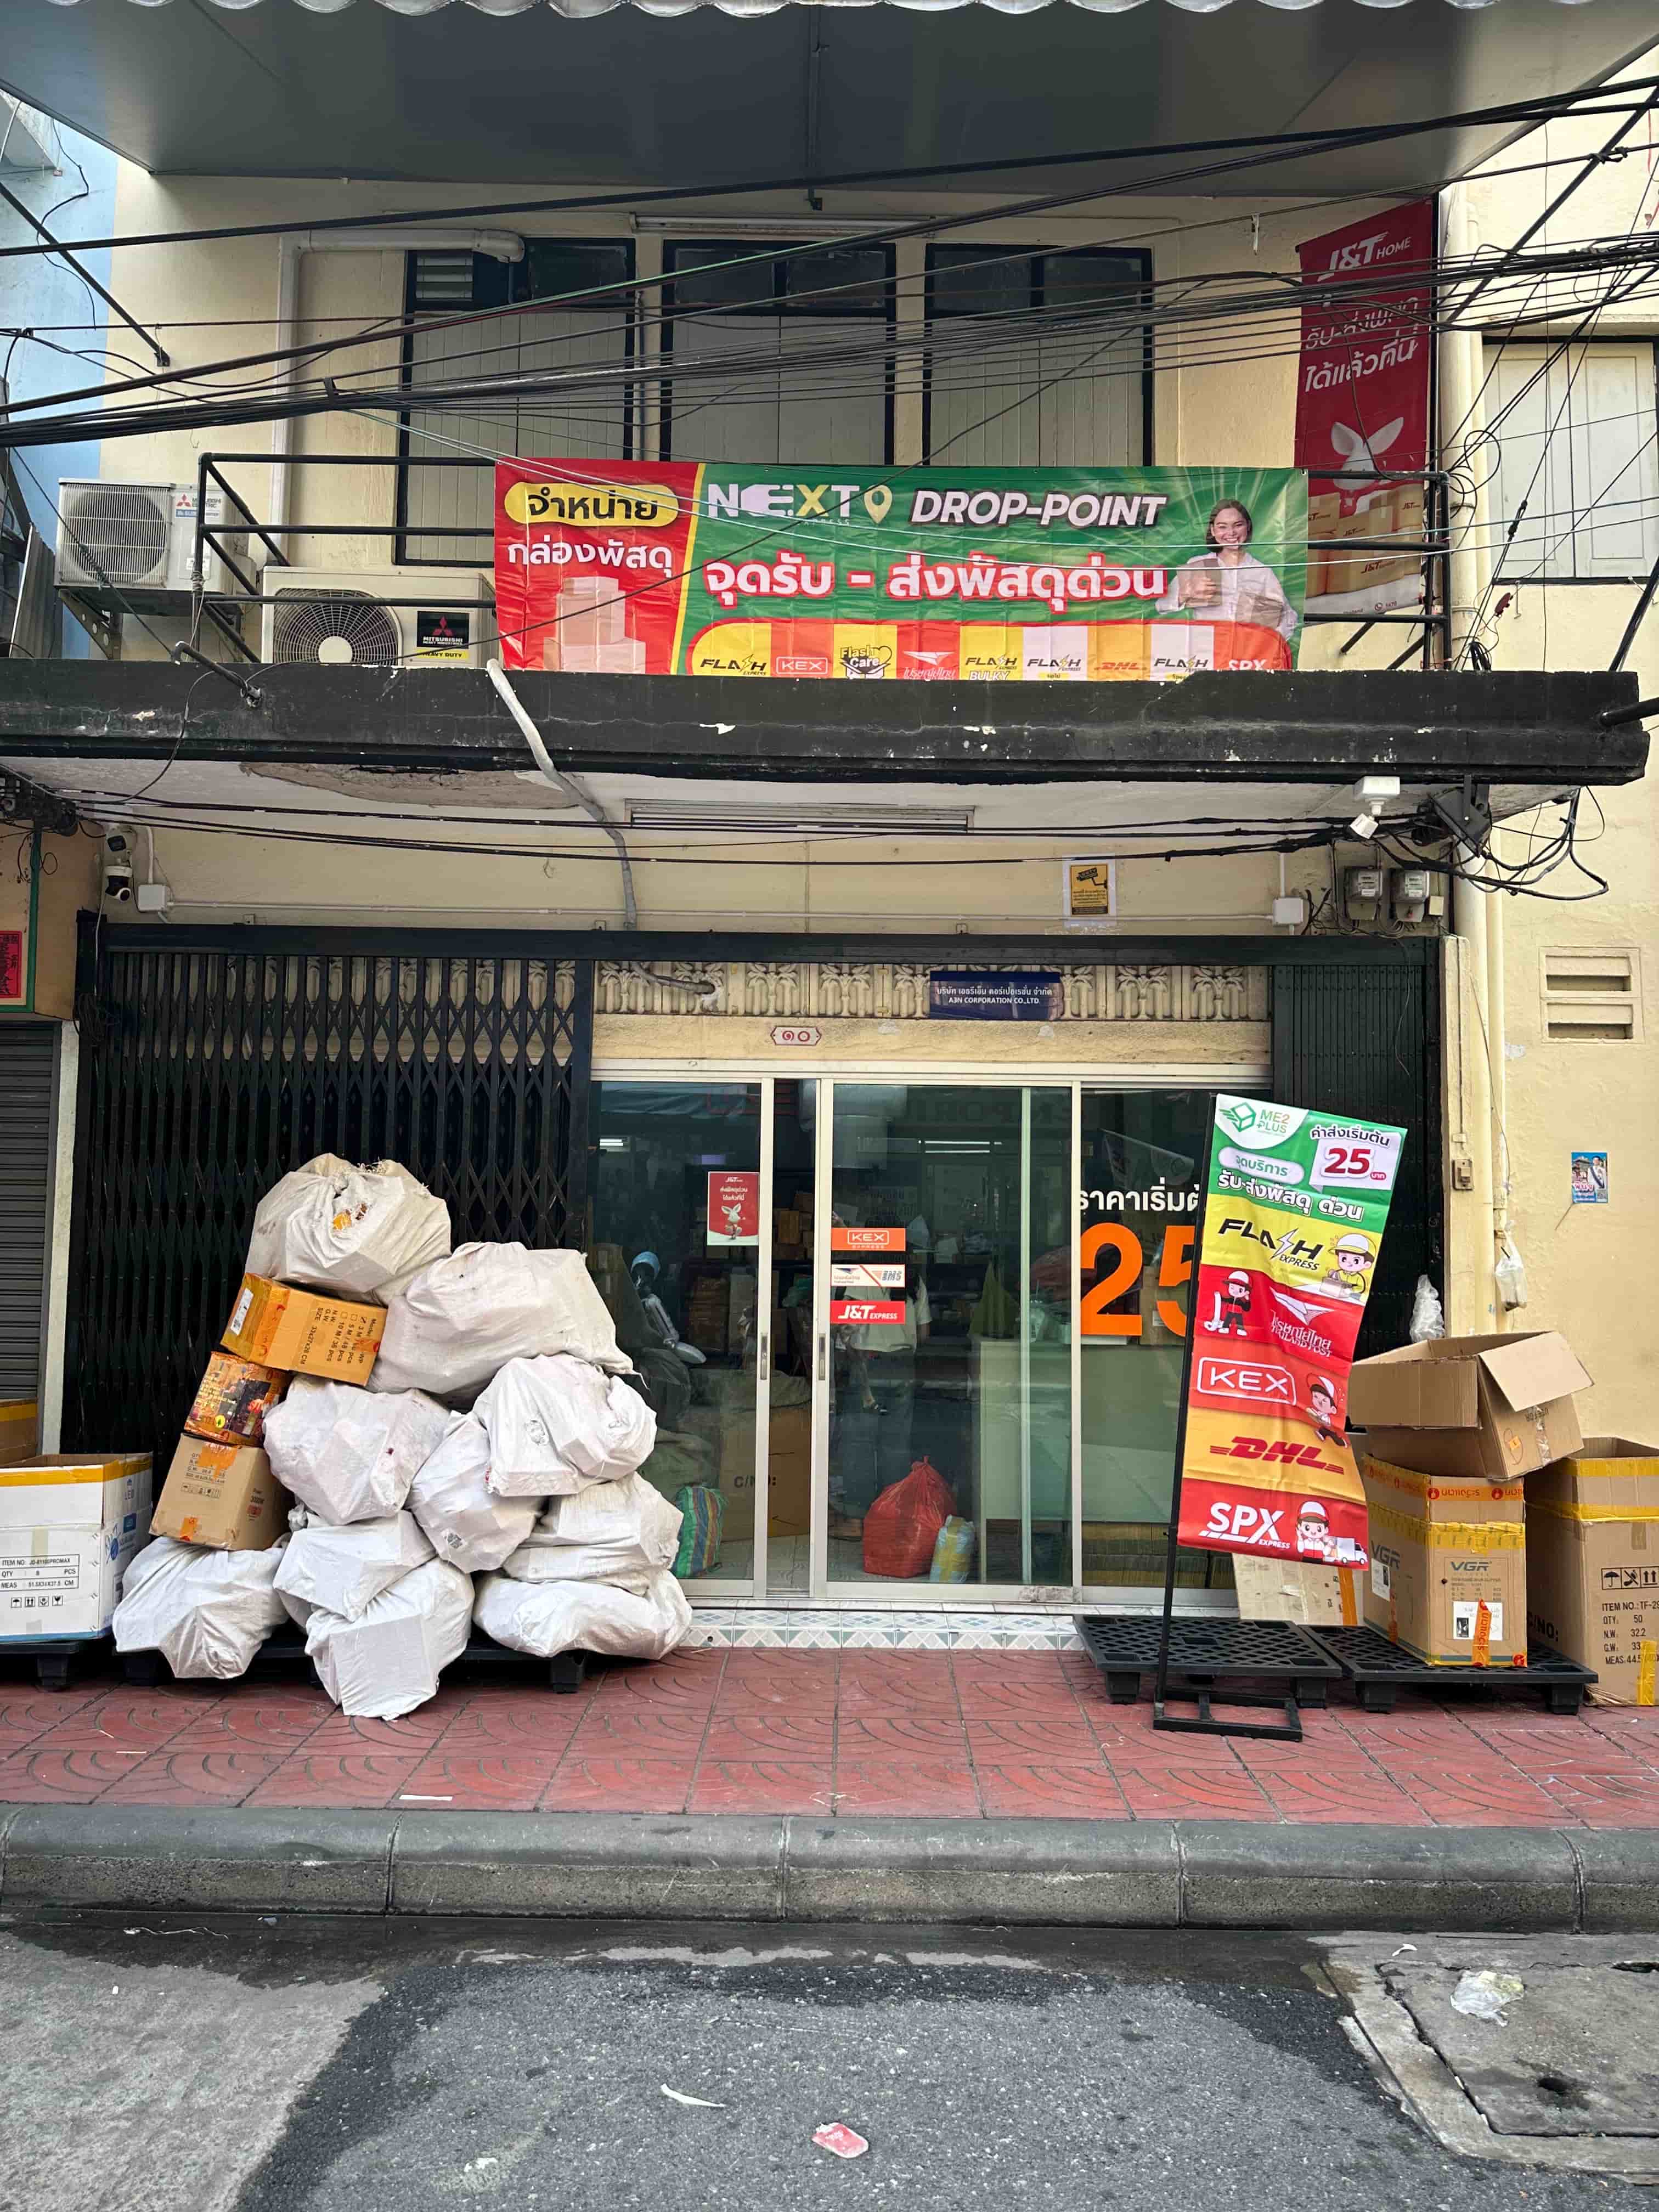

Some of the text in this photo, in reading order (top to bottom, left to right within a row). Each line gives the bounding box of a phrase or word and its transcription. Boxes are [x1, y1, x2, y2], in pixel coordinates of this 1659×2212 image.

[1376, 237, 1412, 259] HOME
[527, 487, 658, 518] จำหน่าย
[708, 483, 1167, 525] NEXT DROP-POINT
[507, 539, 672, 577] กล่องพัสดุ
[706, 553, 832, 605] จุดรับ
[889, 554, 1166, 612] ส่งพัสดุด่วน
[840, 645, 874, 659] Flash
[781, 660, 822, 670] KEX
[850, 658, 880, 668] Care
[969, 670, 1010, 680] BULKY
[937, 986, 956, 995] บริษัท
[1311, 1126, 1390, 1146] ค่าส่งเริ่มต้น
[1236, 1155, 1288, 1177] จุดบริการ
[1324, 1148, 1371, 1175] 25
[1318, 1197, 1364, 1221] ด่วน
[851, 1233, 885, 1242] KEX
[1279, 1253, 1320, 1271] EXPRESS
[838, 1305, 877, 1319] J&T
[1210, 1366, 1289, 1395] KEX
[1224, 1436, 1330, 1470] DHL
[1206, 1502, 1285, 1543] SPX
[1258, 1539, 1291, 1550] EXPRESS
[1450, 1561, 1489, 1571] VGR
[1602, 1602, 1620, 1611] ITEM
[1633, 1615, 1643, 1623] 50
[1630, 1628, 1646, 1637] 32.2
